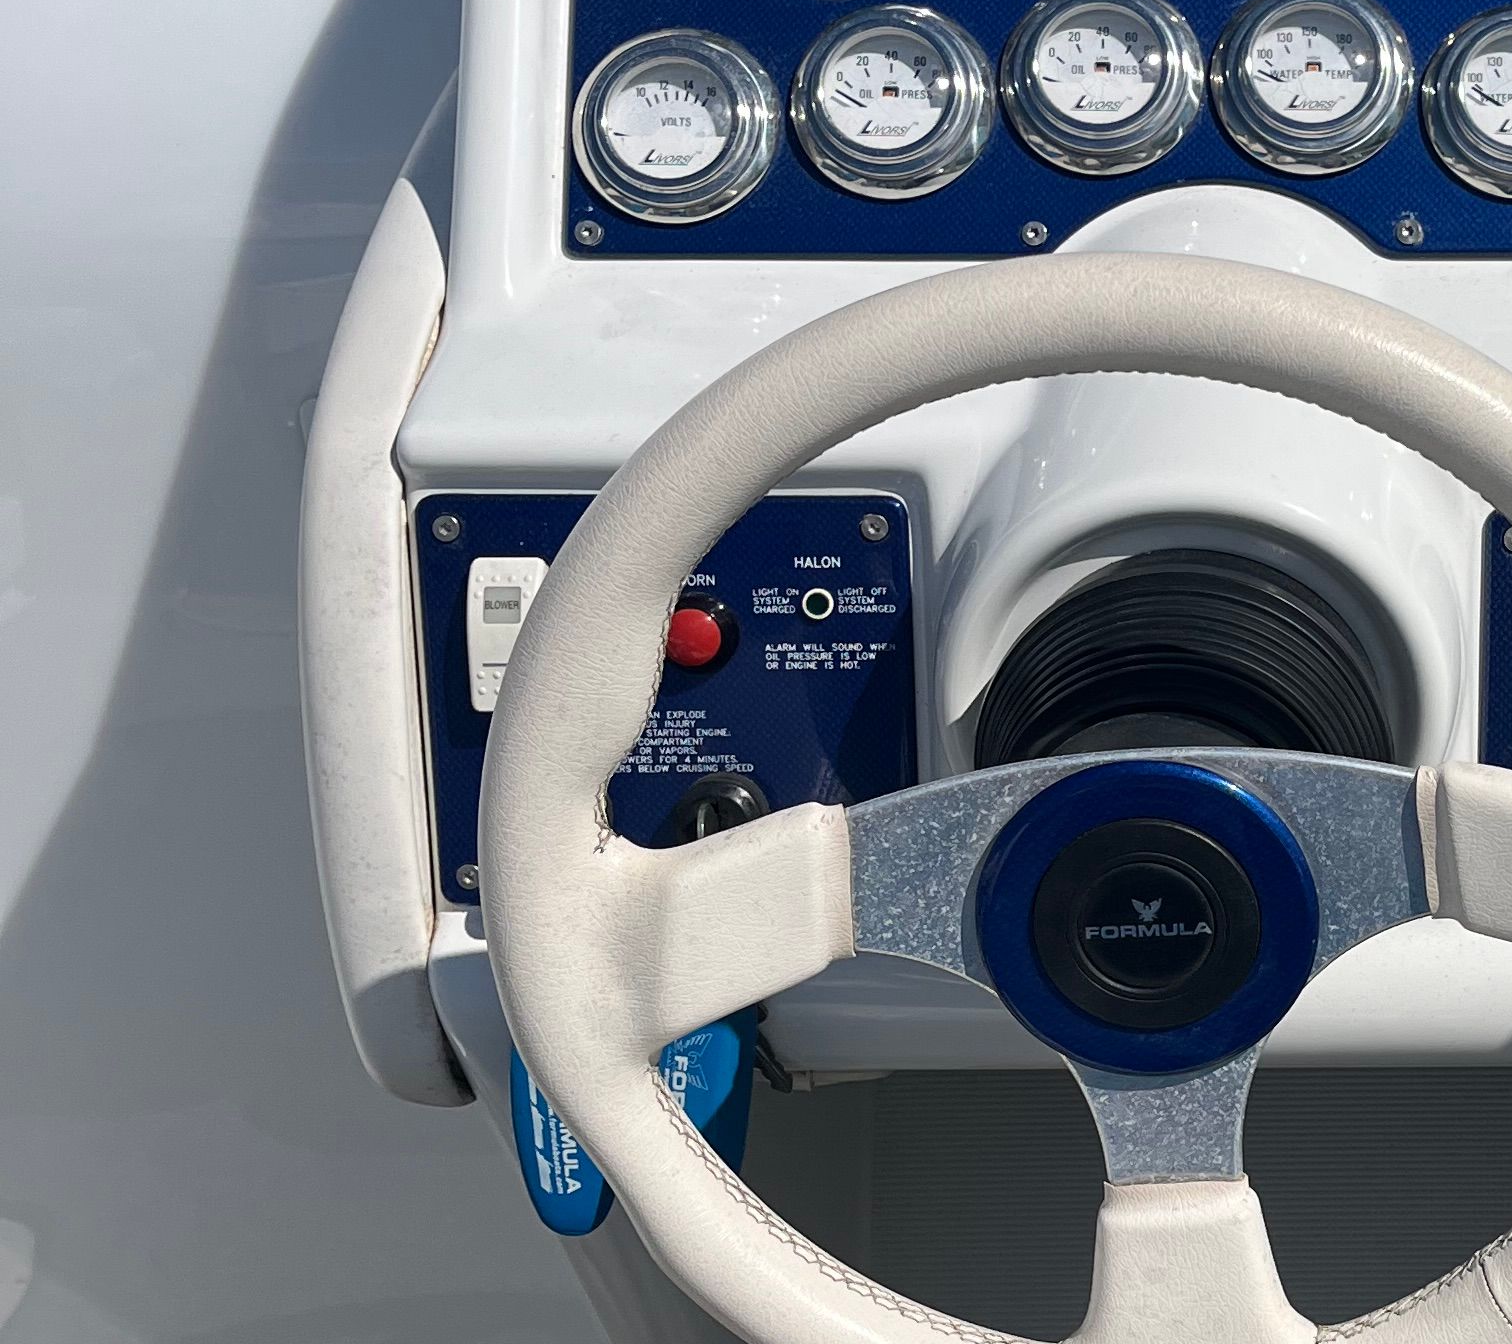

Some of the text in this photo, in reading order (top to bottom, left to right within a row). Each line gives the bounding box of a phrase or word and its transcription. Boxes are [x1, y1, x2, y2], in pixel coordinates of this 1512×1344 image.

[1257, 33, 1292, 59] 100 130
[837, 56, 869, 81] 0 20
[1072, 66, 1144, 75] OIL PRESS
[1270, 69, 1352, 79] WATER TEMP
[636, 81, 716, 97] 10 12 14 16
[860, 89, 932, 99] OIL PRESS
[661, 118, 691, 126] VOLTS
[794, 557, 840, 568] HALON
[687, 574, 716, 587] ORN
[753, 588, 799, 596] LIGHT ON
[838, 587, 863, 595] LIGHT
[838, 596, 875, 604] SYSTEM
[484, 600, 520, 610] BLOWER
[839, 605, 896, 613] DISCHARGED
[754, 606, 795, 614] CHARGED
[765, 643, 796, 651] ALARM
[832, 643, 863, 651] SOUND
[841, 652, 849, 660] IS
[857, 652, 876, 660] LOW
[667, 711, 706, 719] EXPLODE
[665, 720, 695, 728] INJURY
[638, 738, 703, 746] COMPARTMENT
[677, 764, 718, 772] CRUISING
[725, 764, 754, 772] SPEED
[1085, 922, 1213, 940] FORMULA
[560, 1127, 581, 1194] MULA
